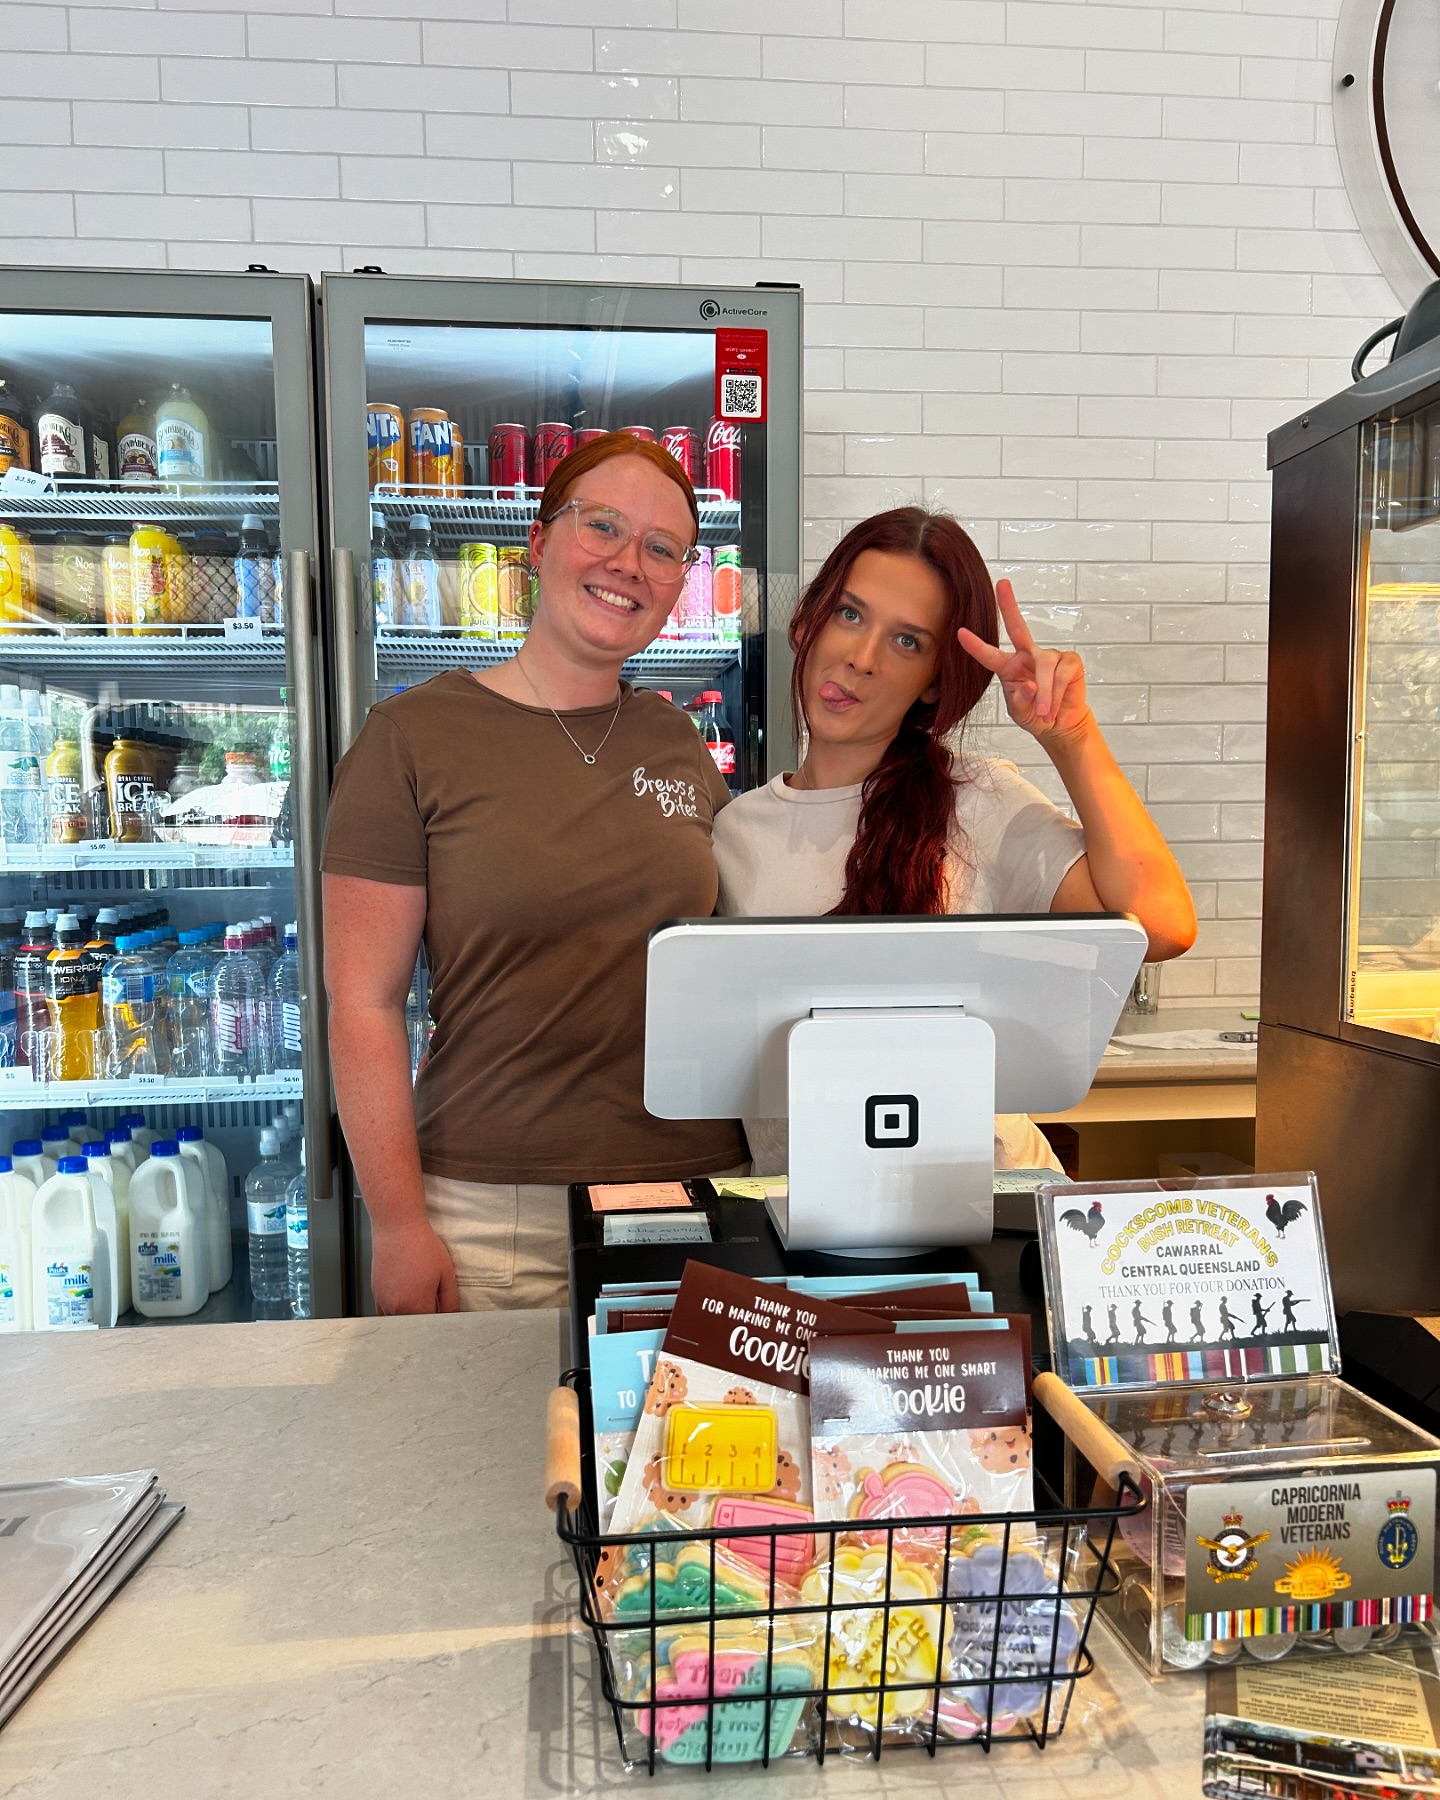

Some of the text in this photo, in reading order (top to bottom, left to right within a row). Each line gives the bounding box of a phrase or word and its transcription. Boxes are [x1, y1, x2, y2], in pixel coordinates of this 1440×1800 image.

[722, 307, 768, 316] ActiveCore
[232, 622, 254, 631] $3.50
[633, 767, 686, 796] Brews
[115, 782, 154, 802] ICE
[657, 792, 699, 818] Bites
[46, 964, 99, 975] POWERADE
[1101, 1198, 1279, 1275] COCKSCOMB VETERANS
[1136, 1219, 1239, 1253] BUSH RETREAT
[154, 1253, 177, 1264] milk
[1156, 1243, 1223, 1258] CAWARRAL
[1121, 1260, 1261, 1278] CENTRAL QUEENSLAND
[64, 1274, 88, 1285] milk
[1099, 1277, 1286, 1298] THANK YOU FOR YOUR DONATION
[701, 1298, 724, 1315] FOR
[728, 1305, 771, 1330] MAKING
[776, 1319, 792, 1336] ME
[754, 1296, 817, 1327] THANK YOU
[886, 1347, 950, 1364] THANK YOU
[867, 1366, 909, 1381] MAKING
[915, 1365, 929, 1379] ME
[935, 1364, 956, 1378] ONE
[961, 1361, 997, 1377] SMART
[617, 1389, 636, 1409] TO
[704, 1444, 713, 1457] 2
[729, 1444, 738, 1458] 3
[752, 1446, 762, 1459] 4
[1271, 1483, 1361, 1506] CAPRICORNIA
[1287, 1503, 1345, 1525] MODERN
[1280, 1522, 1351, 1544] VETERANS
